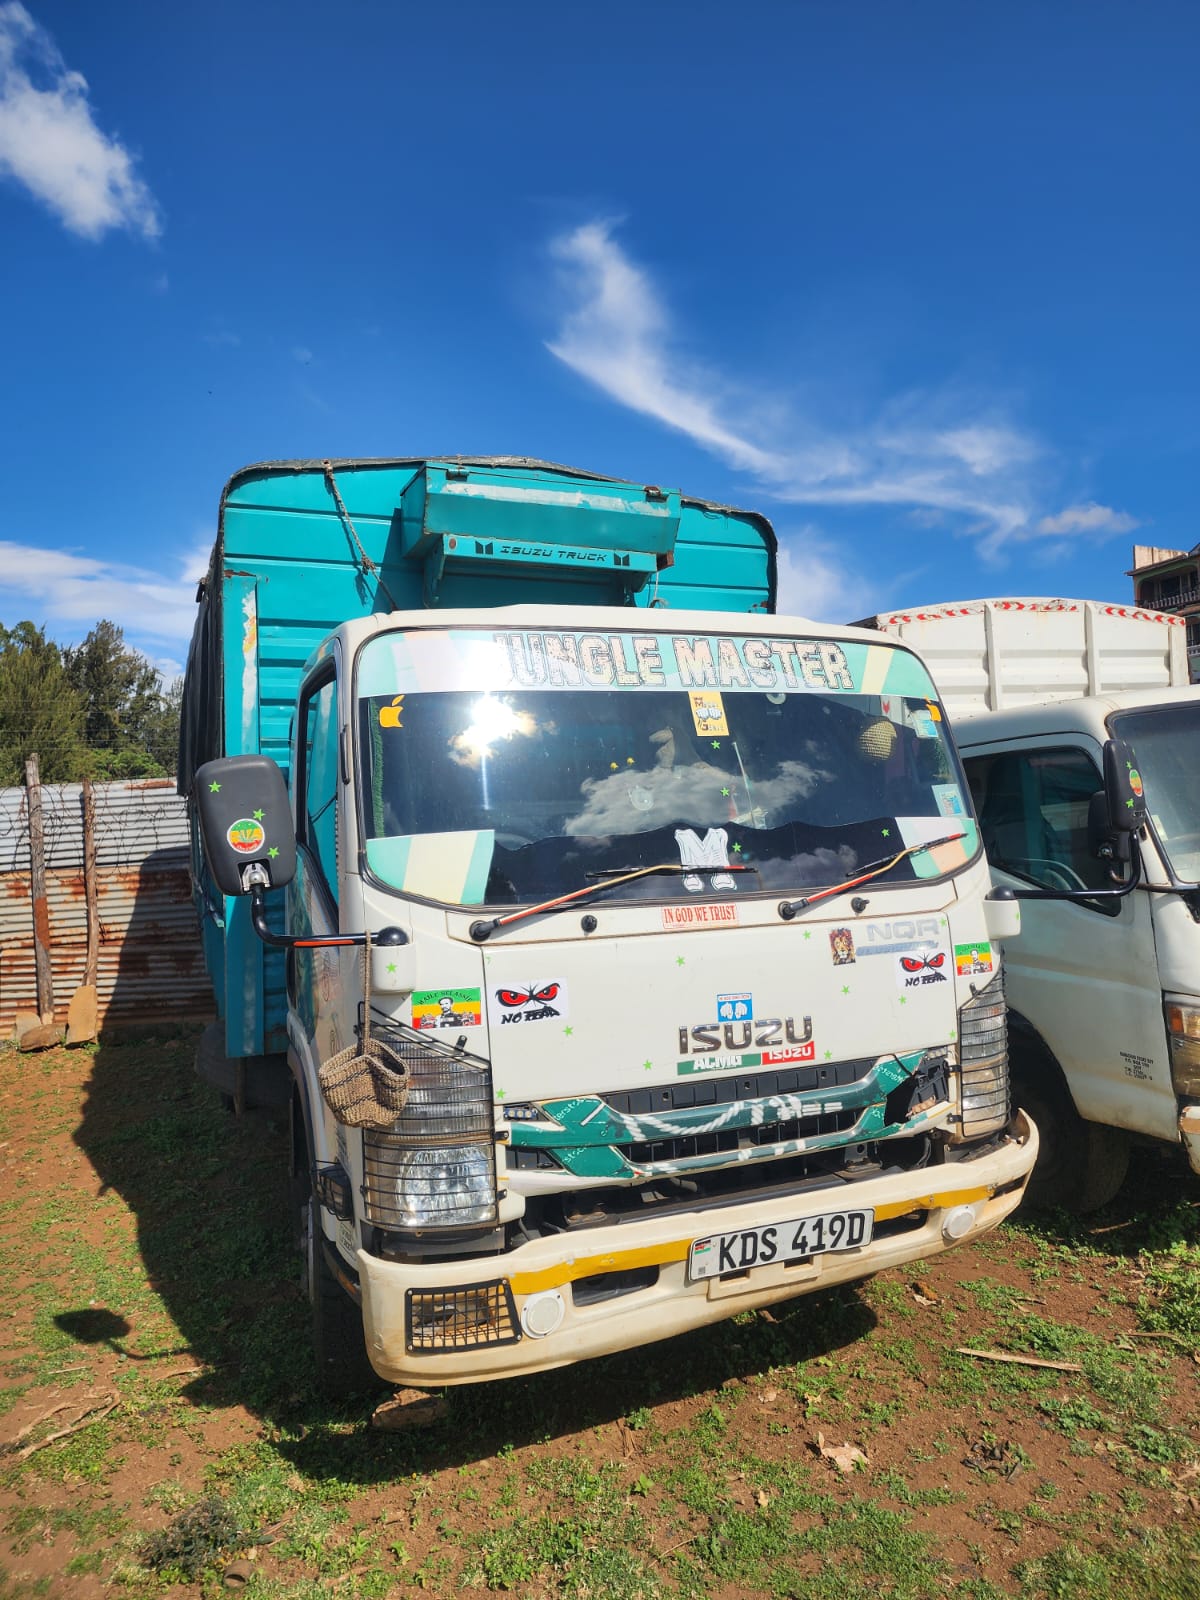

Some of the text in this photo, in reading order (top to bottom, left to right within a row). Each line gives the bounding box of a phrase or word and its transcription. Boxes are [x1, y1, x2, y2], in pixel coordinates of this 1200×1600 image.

[500, 544, 607, 562] ISUZU TRUCK
[672, 637, 855, 690] MASTER
[664, 904, 736, 923] IN GOD WE TRUST
[867, 919, 940, 941] NQR
[501, 1012, 522, 1025] NO
[679, 1016, 813, 1054] ISUZU
[768, 1046, 812, 1060] ISUZU
[719, 1212, 866, 1271] KDS 419D
